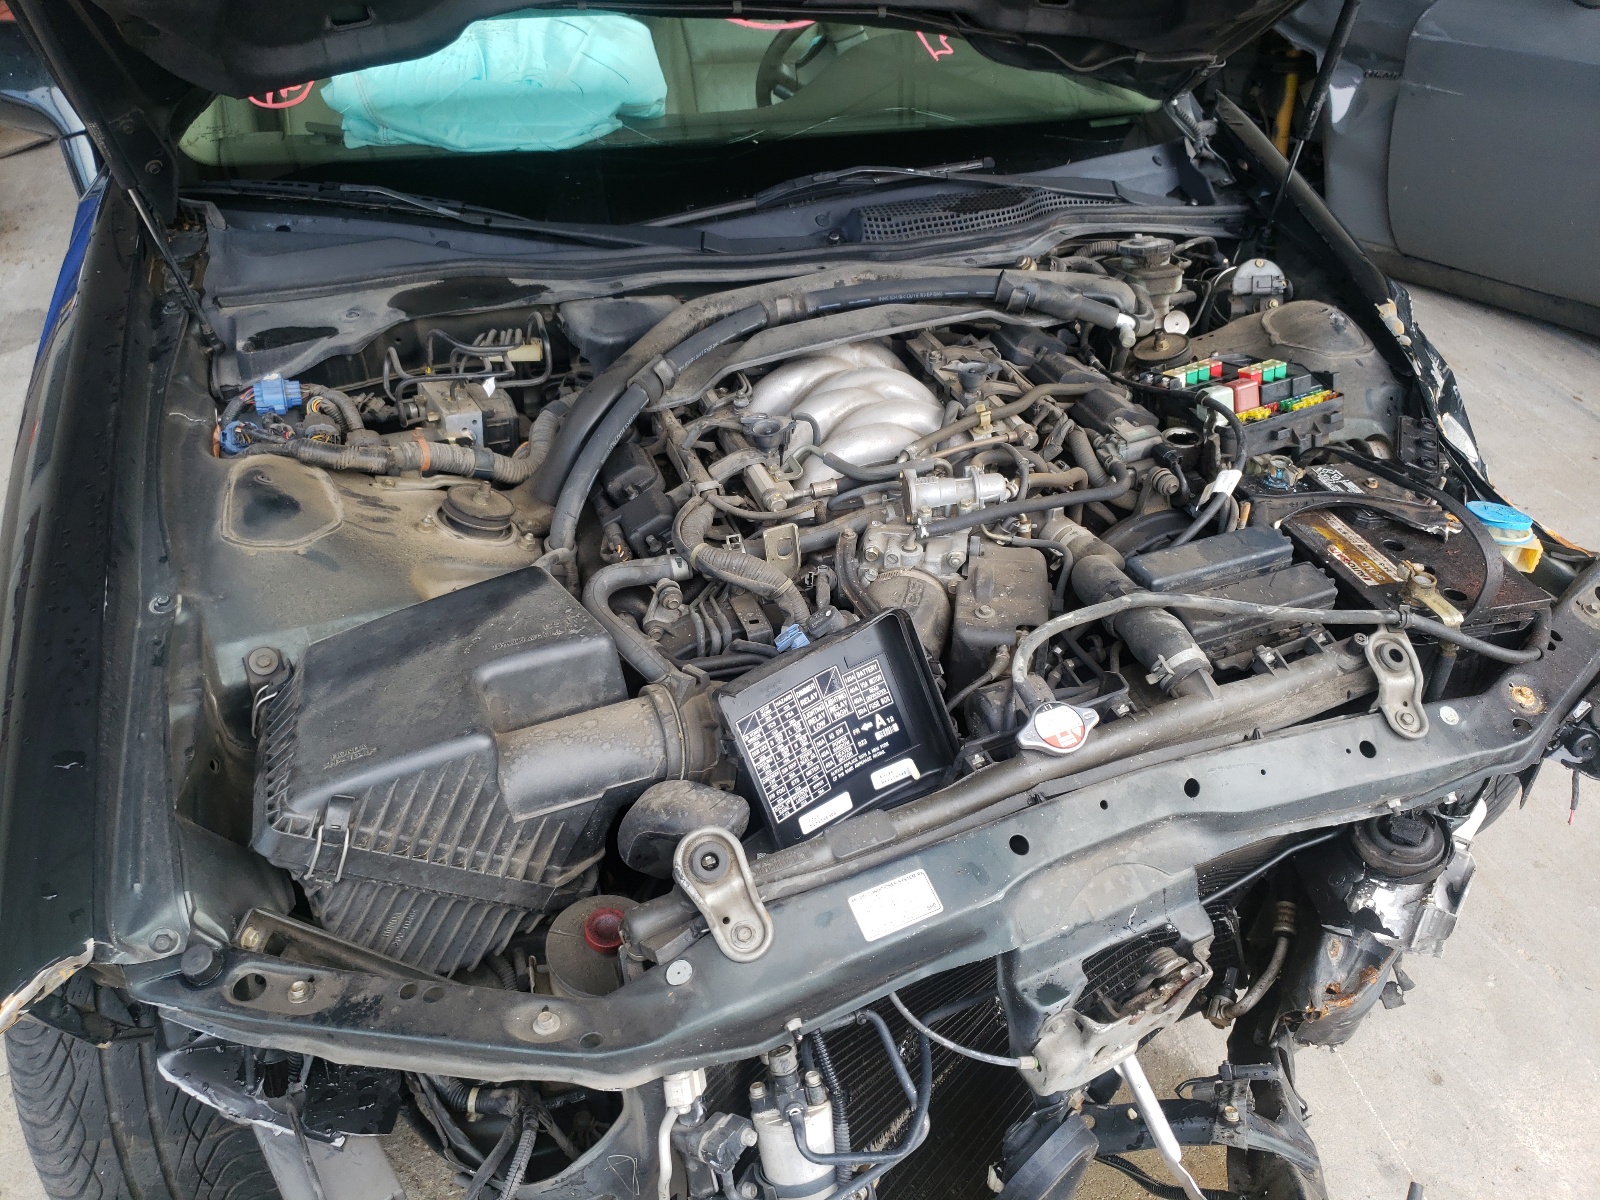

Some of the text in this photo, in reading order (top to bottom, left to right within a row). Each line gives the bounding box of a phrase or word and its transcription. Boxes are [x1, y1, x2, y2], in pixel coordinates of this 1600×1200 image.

[856, 664, 876, 677] BATTERY
[774, 693, 792, 706] HAZARD
[800, 692, 818, 705] RELAY
[868, 700, 879, 709] FUSE
[829, 699, 848, 713] RELAY
[808, 711, 825, 725] RELAY
[833, 707, 848, 719] HIGH
[813, 719, 826, 731] LOW
[875, 713, 886, 729] A
